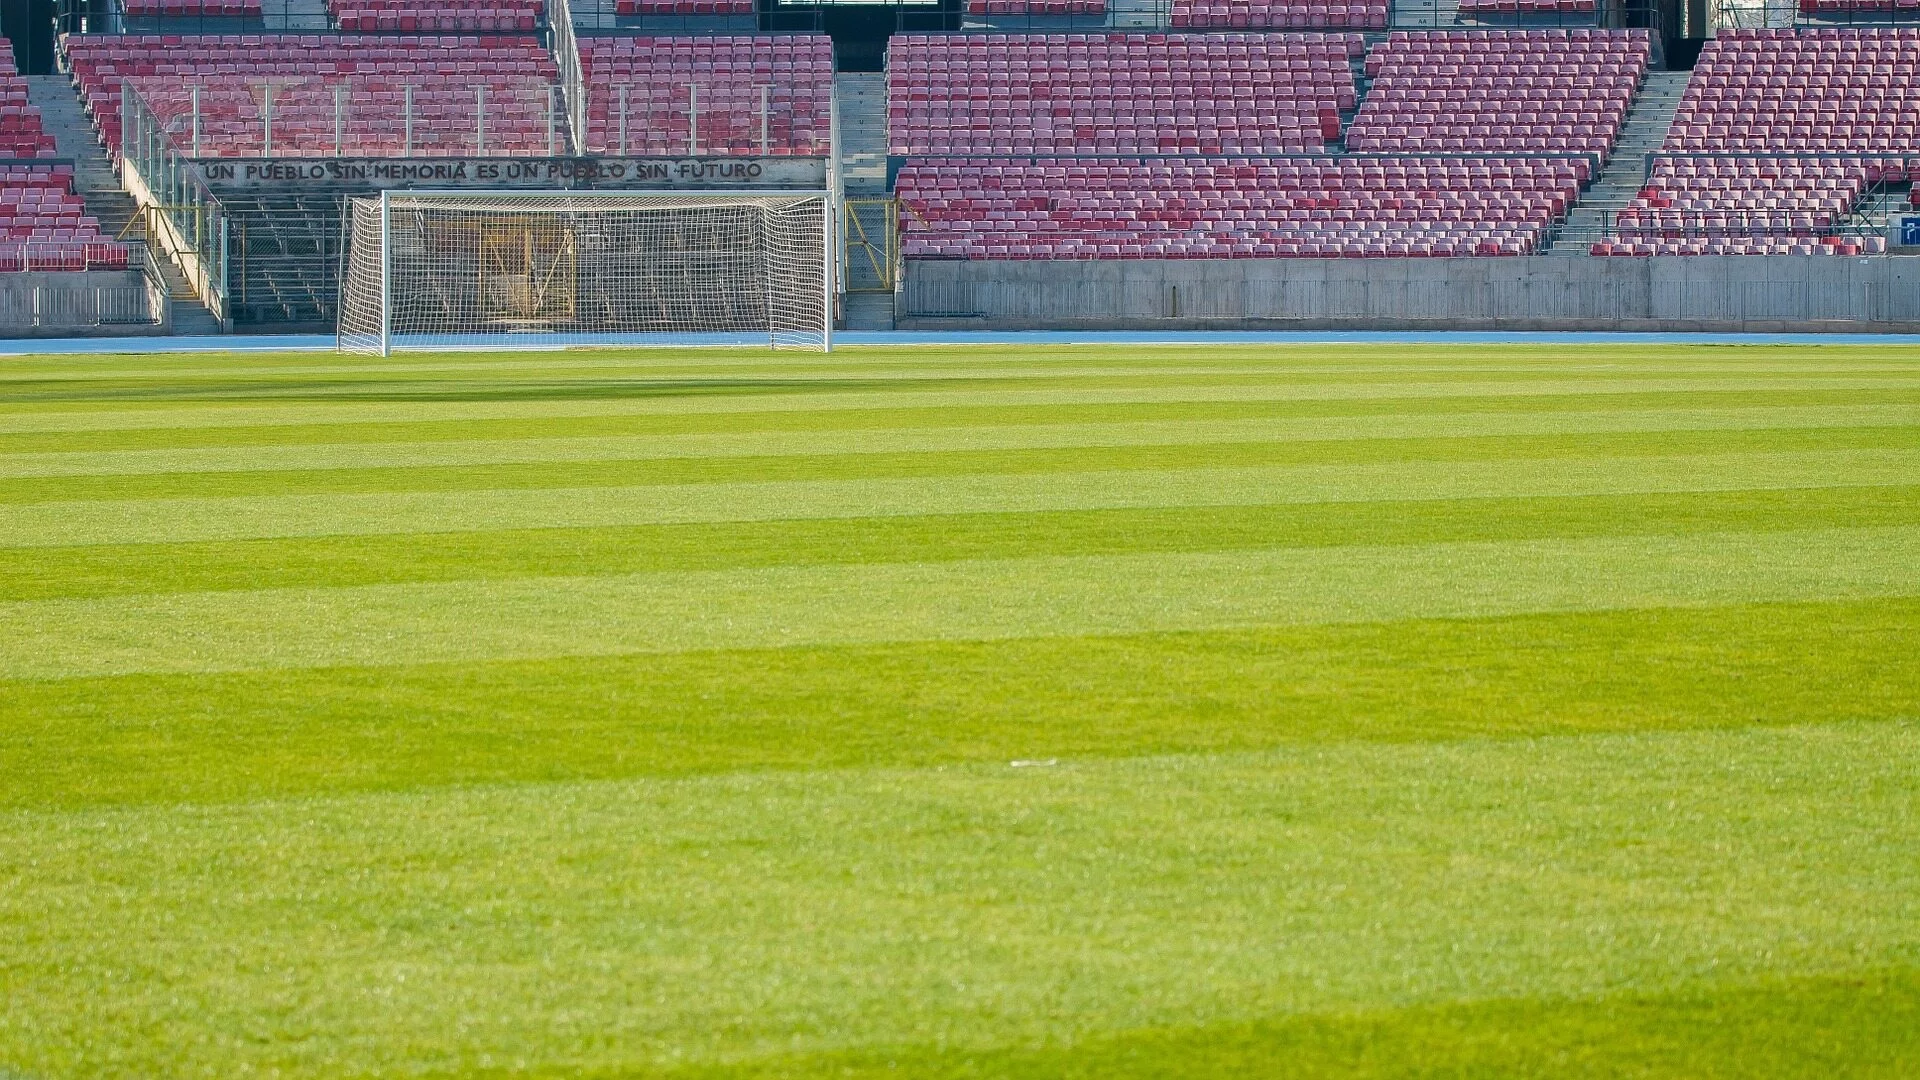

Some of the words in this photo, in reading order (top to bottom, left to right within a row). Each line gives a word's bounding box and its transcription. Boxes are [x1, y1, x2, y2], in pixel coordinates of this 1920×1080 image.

[205, 165, 235, 180] UN
[246, 164, 325, 180] PUEBLO
[332, 164, 366, 180] SIN
[374, 164, 467, 180] MEMORIA
[477, 164, 500, 179] ES
[506, 164, 539, 178] UN
[547, 164, 627, 179] PUEBLO
[635, 163, 669, 179] SIN
[679, 162, 764, 178] FUTURO
